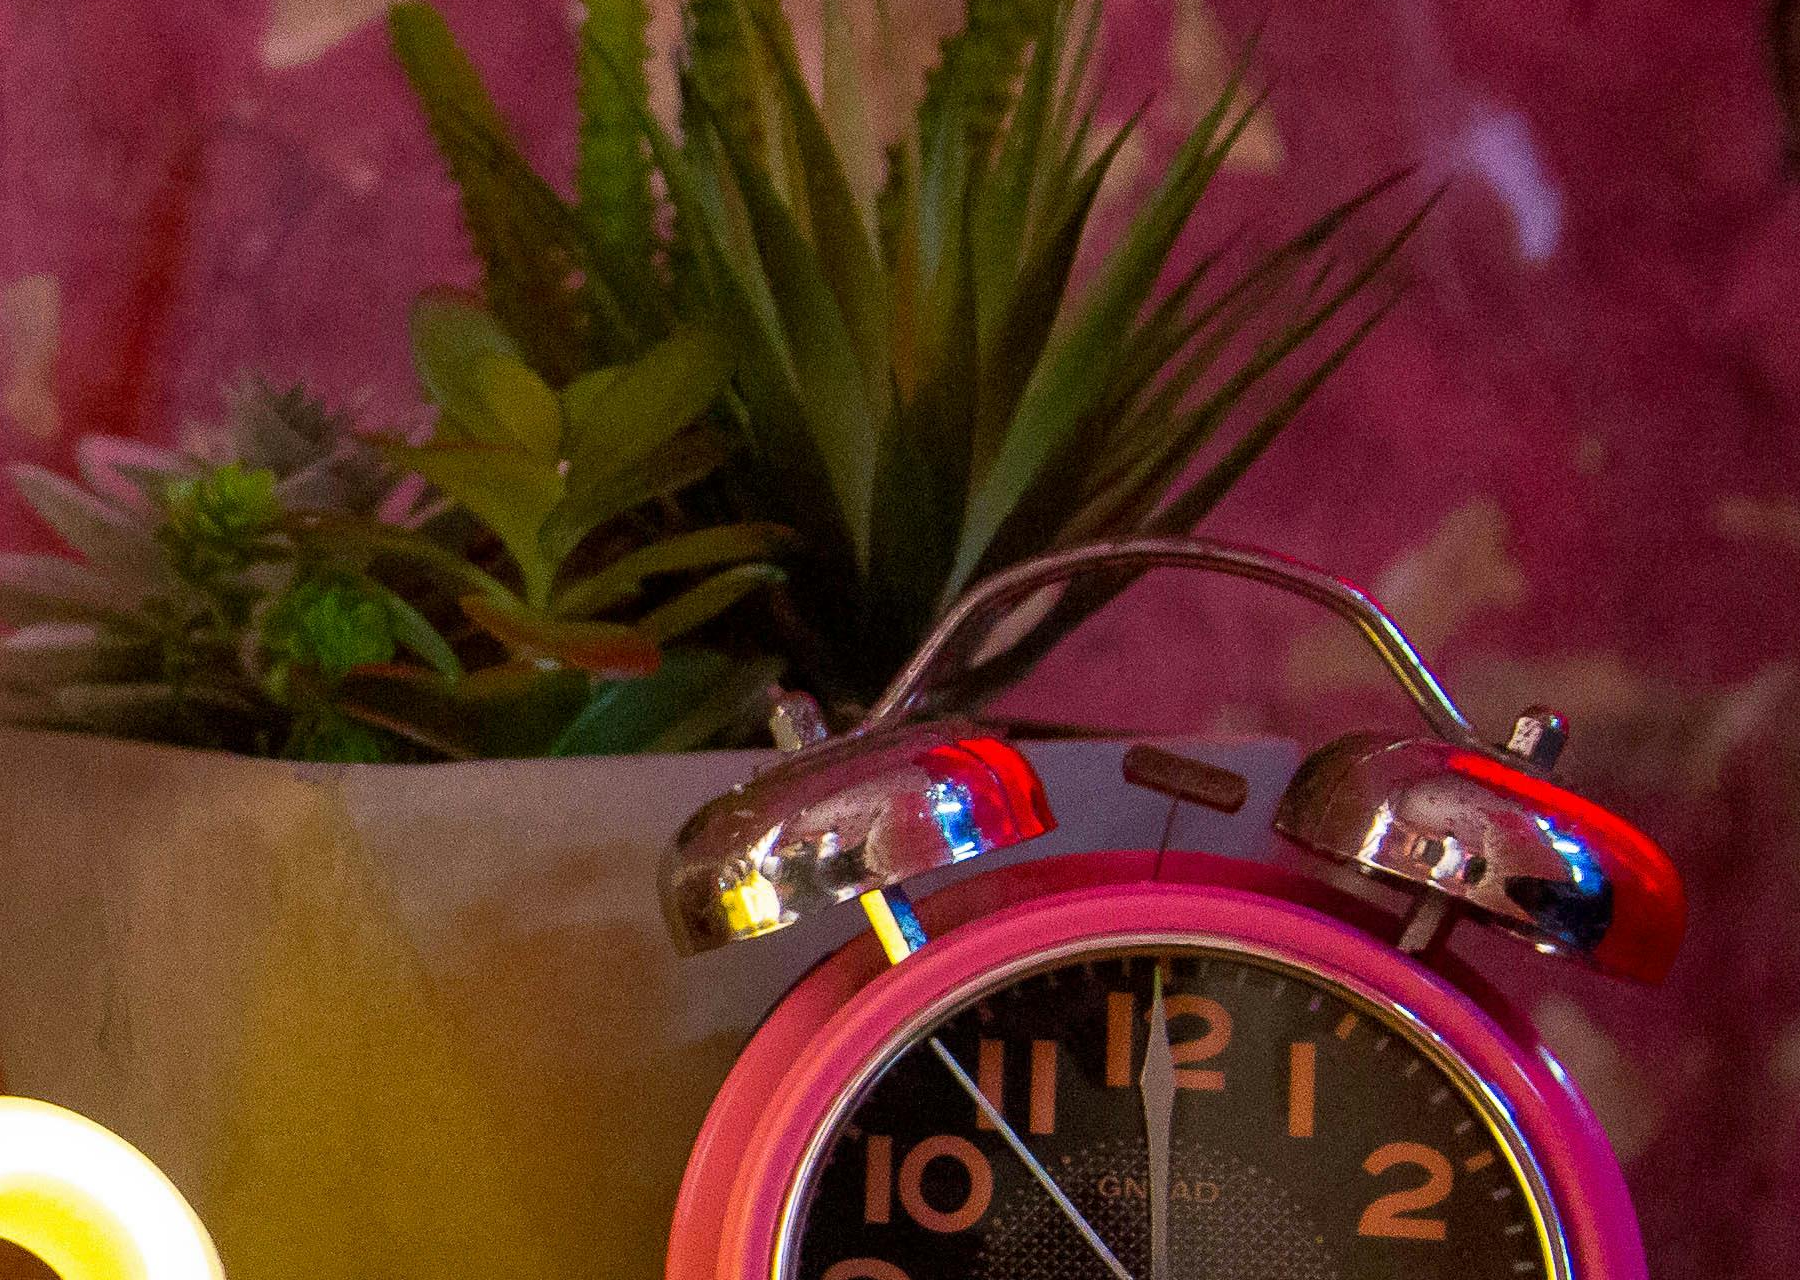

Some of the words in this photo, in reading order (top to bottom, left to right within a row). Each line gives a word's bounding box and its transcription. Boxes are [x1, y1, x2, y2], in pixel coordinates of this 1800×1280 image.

[976, 1040, 1057, 1135] 11
[1105, 992, 1232, 1092] 12
[1289, 1042, 1316, 1138] 1
[864, 1134, 994, 1233] 10
[1098, 1175, 1221, 1203] GNAD
[1358, 1142, 1455, 1241] 2
